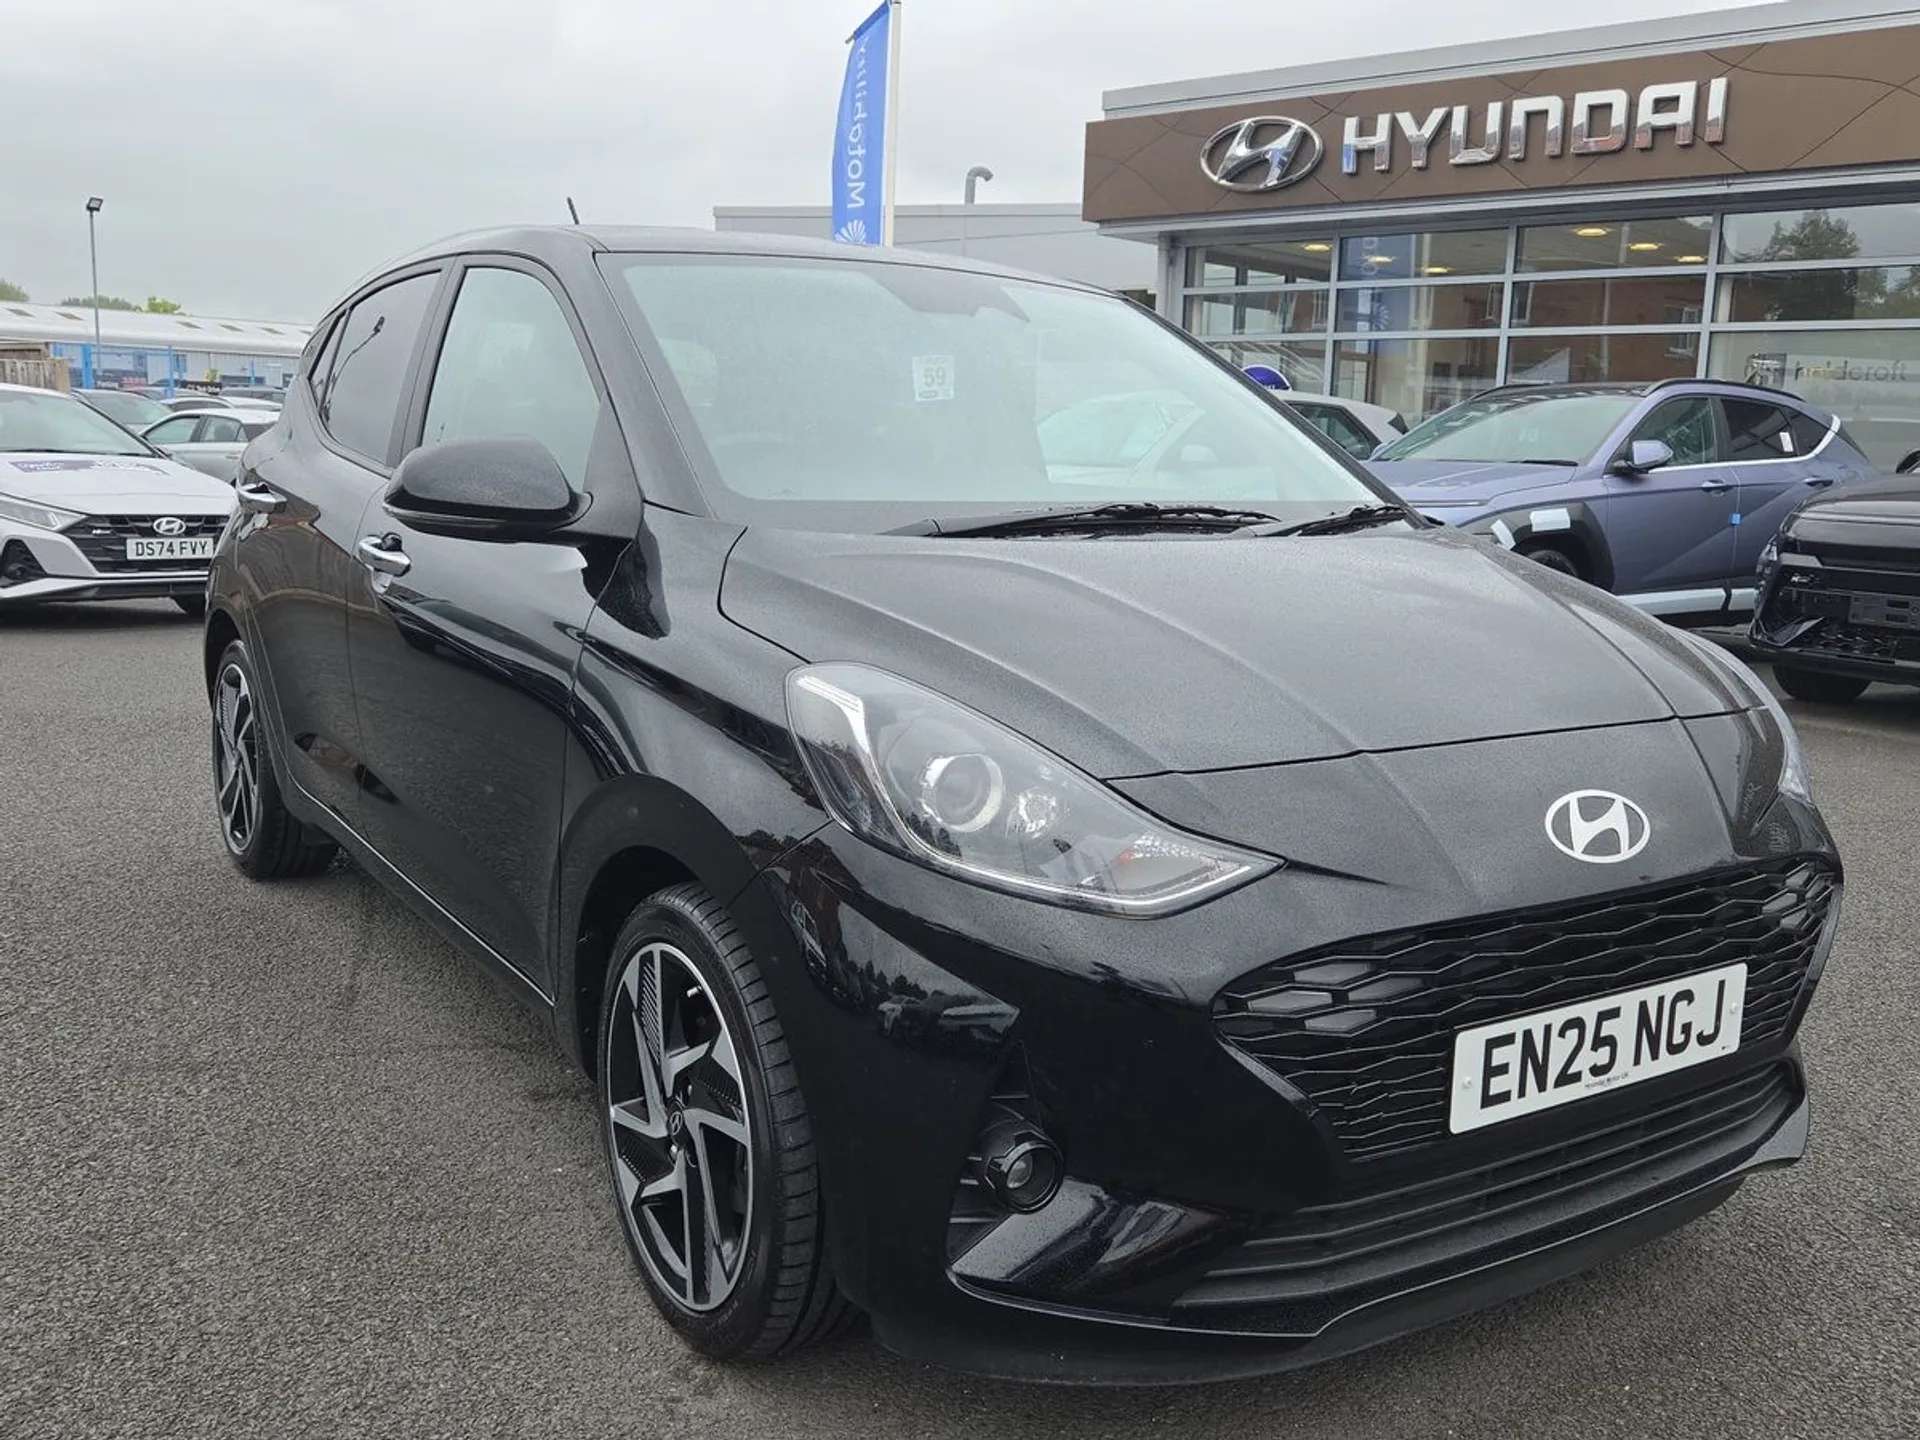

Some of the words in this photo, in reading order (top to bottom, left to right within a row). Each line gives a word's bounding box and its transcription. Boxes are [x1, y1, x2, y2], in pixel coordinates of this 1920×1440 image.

[1341, 77, 1728, 175] HYUNDAI
[135, 541, 175, 557] DS74
[179, 540, 207, 556] FVY
[1480, 1006, 1621, 1109] EN25
[1632, 979, 1726, 1067] NGJ
